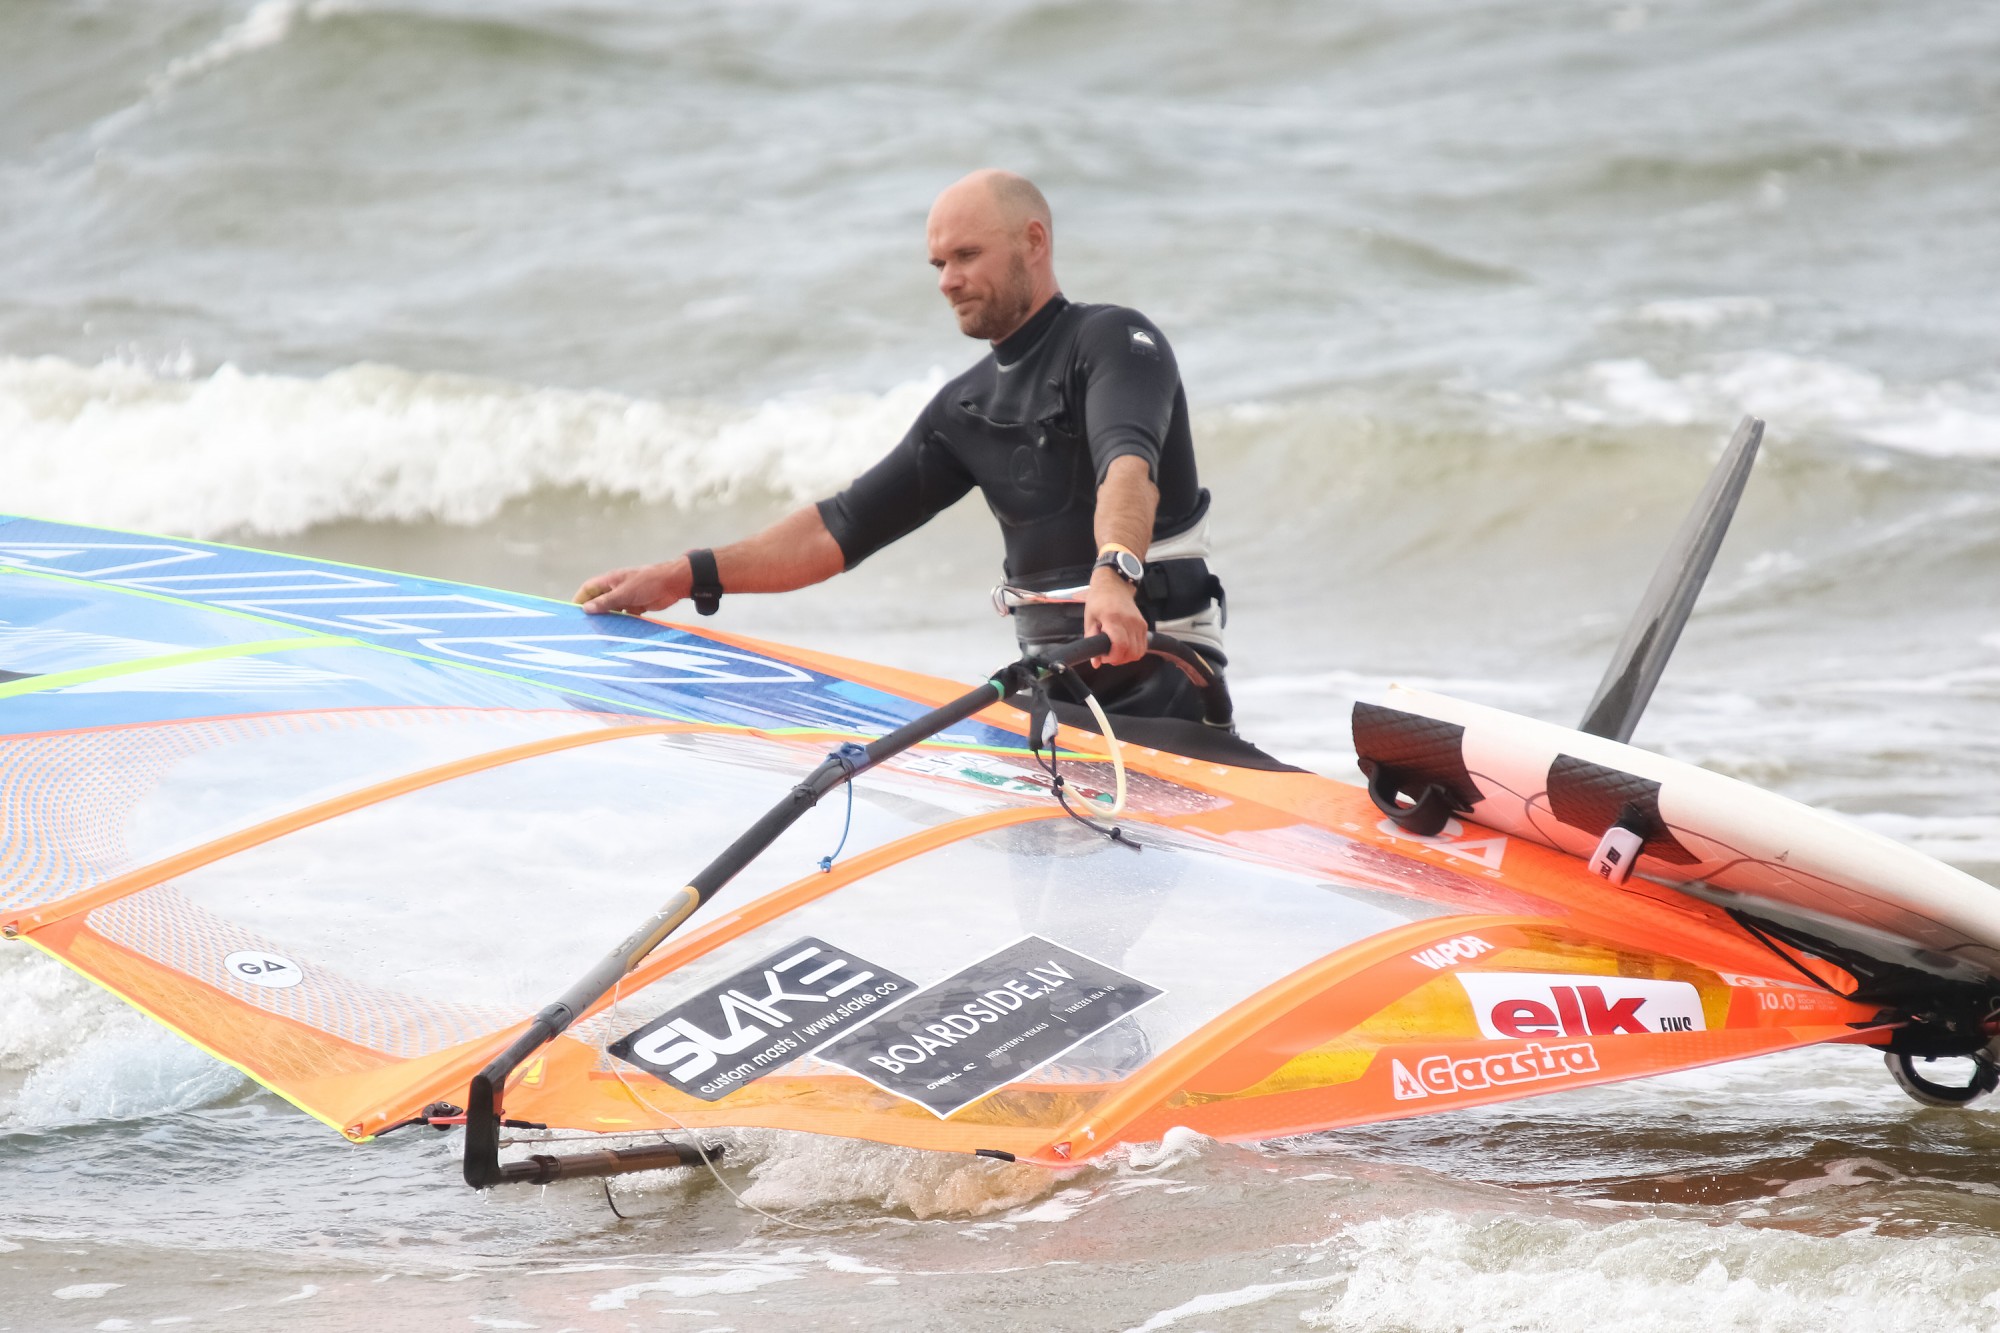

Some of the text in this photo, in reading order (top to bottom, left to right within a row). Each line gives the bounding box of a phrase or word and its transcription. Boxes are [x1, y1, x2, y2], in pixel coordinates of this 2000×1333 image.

[1411, 935, 1495, 970] VAPOR
[633, 946, 874, 1084] SLAKE
[1491, 985, 1692, 1039] elk FINS
[1757, 992, 1796, 1010] 10.0
[700, 1062, 756, 1094] custom
[752, 1037, 797, 1068] masts
[804, 981, 898, 1037] www.slake.co
[1021, 1022, 1050, 1039] VEIKALS
[1417, 1043, 1600, 1095] Gaastra
